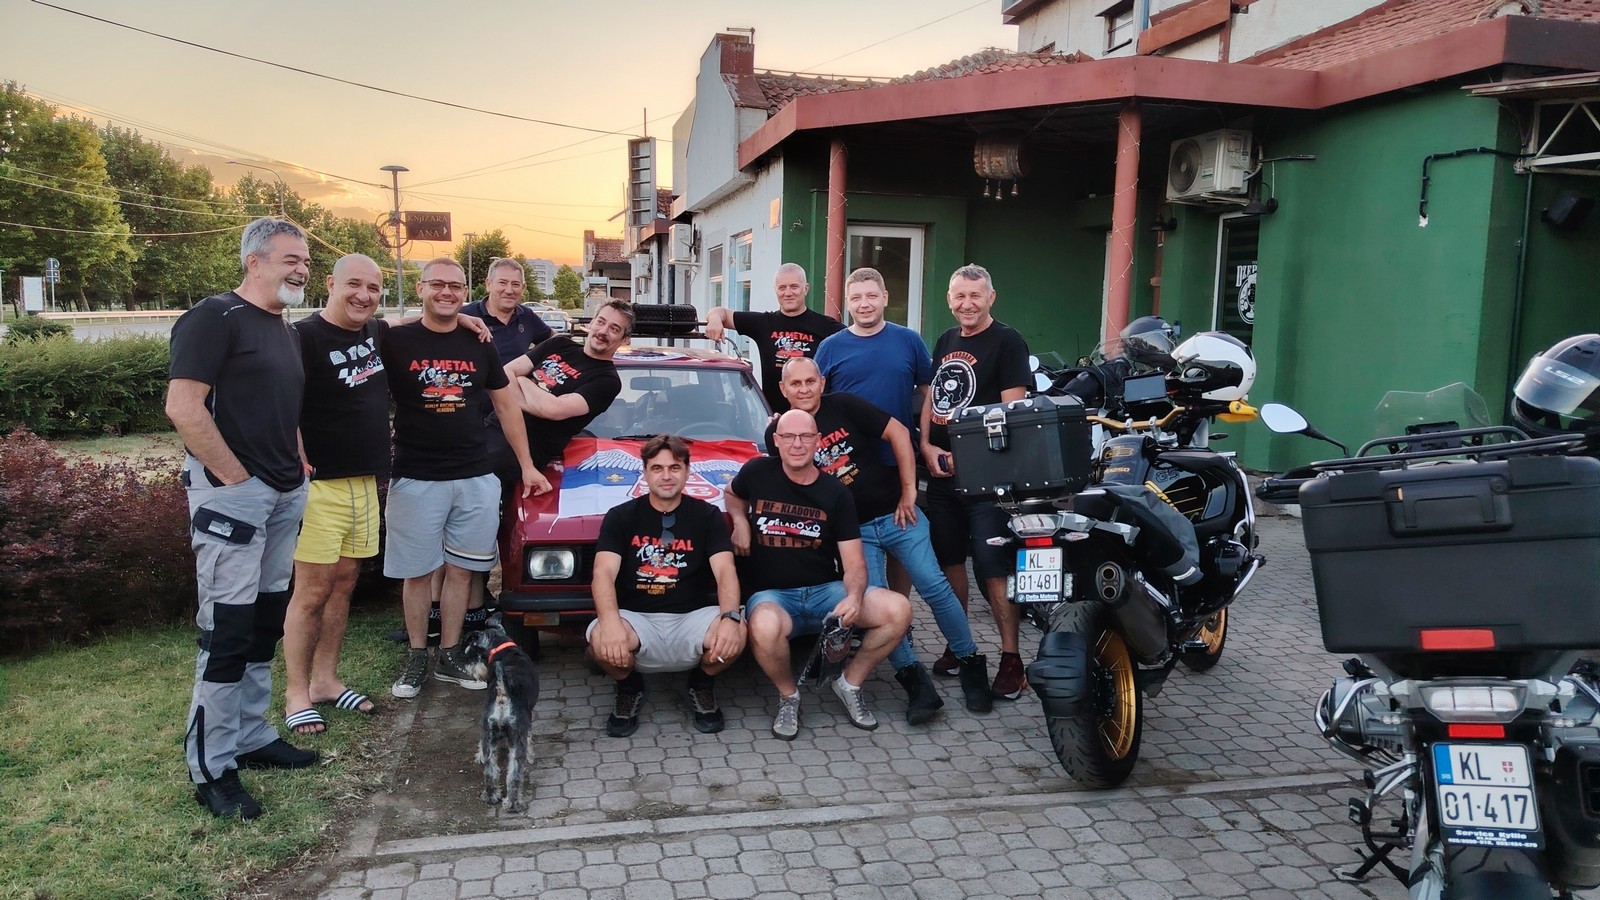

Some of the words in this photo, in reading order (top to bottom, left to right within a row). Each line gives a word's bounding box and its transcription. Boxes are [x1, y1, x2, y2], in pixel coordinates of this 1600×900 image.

[418, 229, 440, 237] ANA
[771, 331, 784, 339] AS
[785, 331, 814, 342] METAL
[409, 359, 429, 371] AS
[432, 359, 477, 372] METAL
[559, 361, 582, 379] METAL
[1155, 468, 1181, 483] GS
[775, 518, 821, 532] KLADOVO
[631, 534, 650, 547] AS
[652, 537, 694, 551] MTAL
[1029, 553, 1044, 569] KL
[1459, 752, 1492, 781] KL
